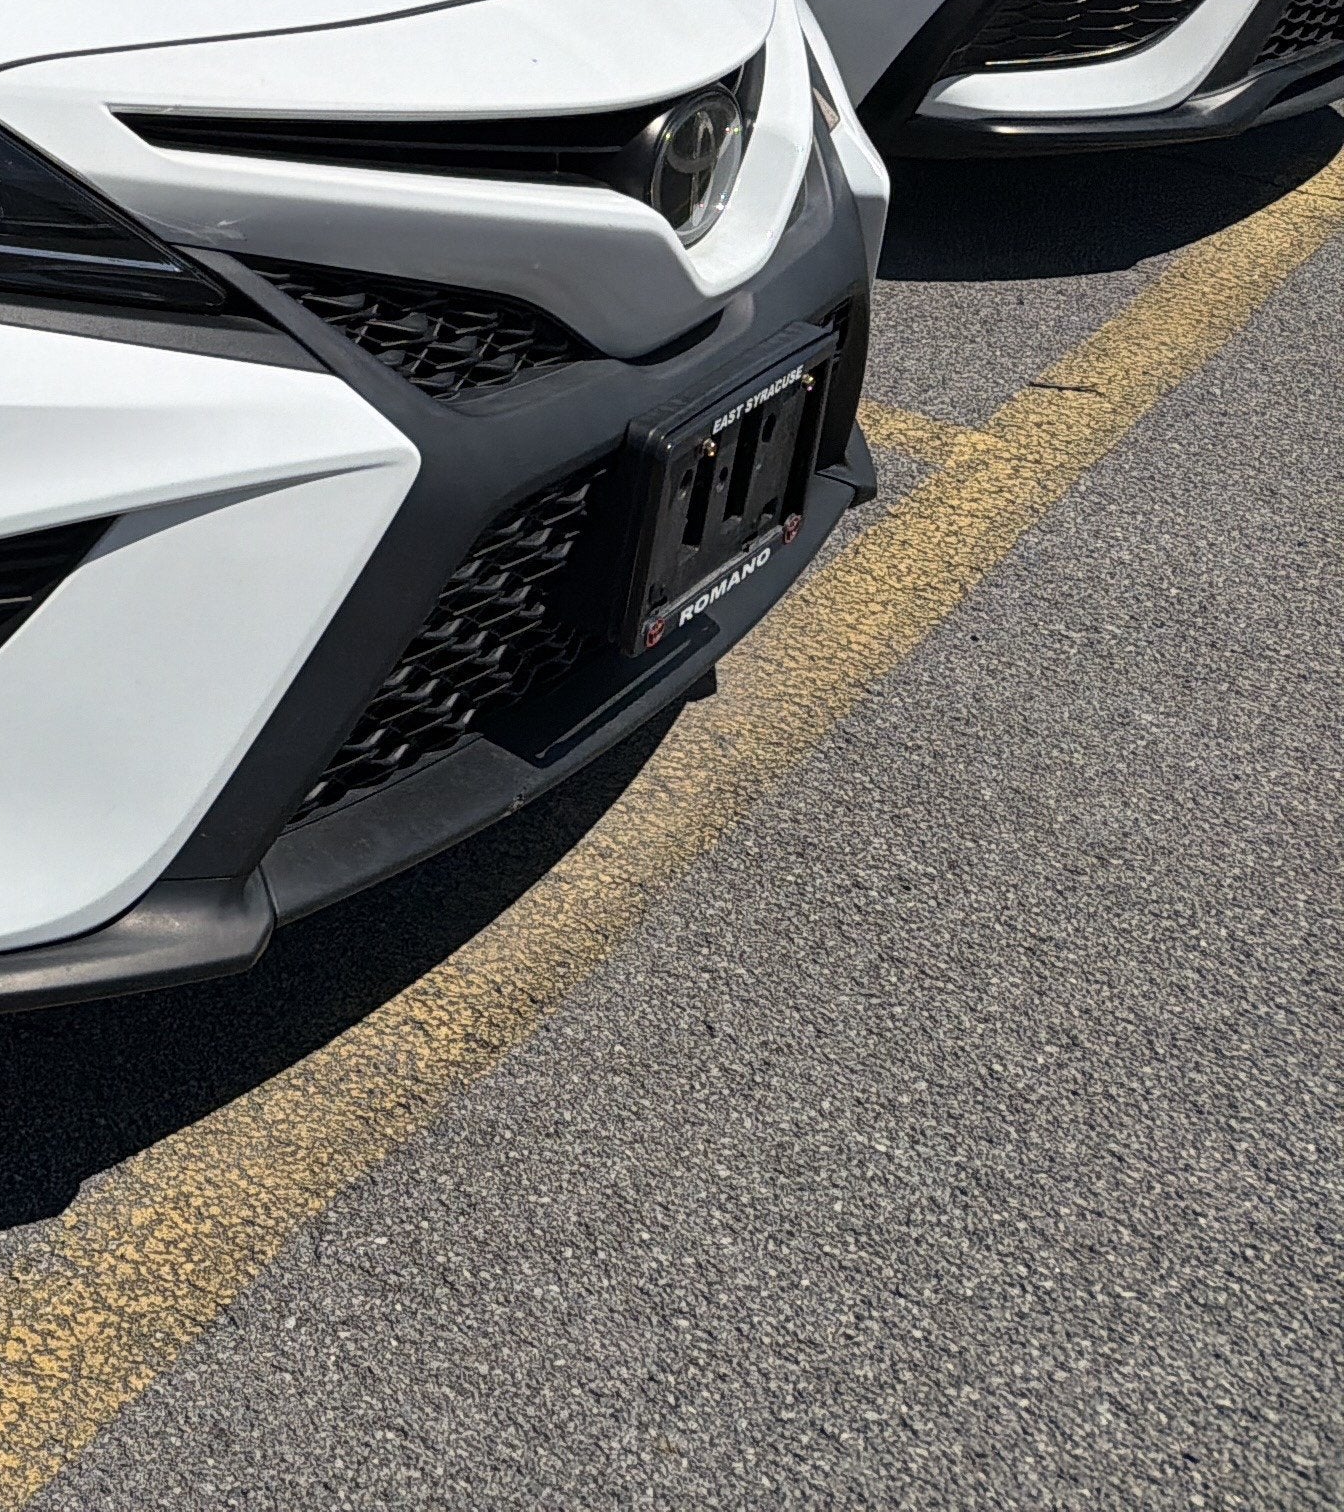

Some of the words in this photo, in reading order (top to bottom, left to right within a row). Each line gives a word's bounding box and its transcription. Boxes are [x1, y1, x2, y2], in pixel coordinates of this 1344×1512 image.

[712, 403, 745, 435] EAST
[744, 364, 804, 414] SYRACUSE
[678, 547, 772, 627] ROMANO
